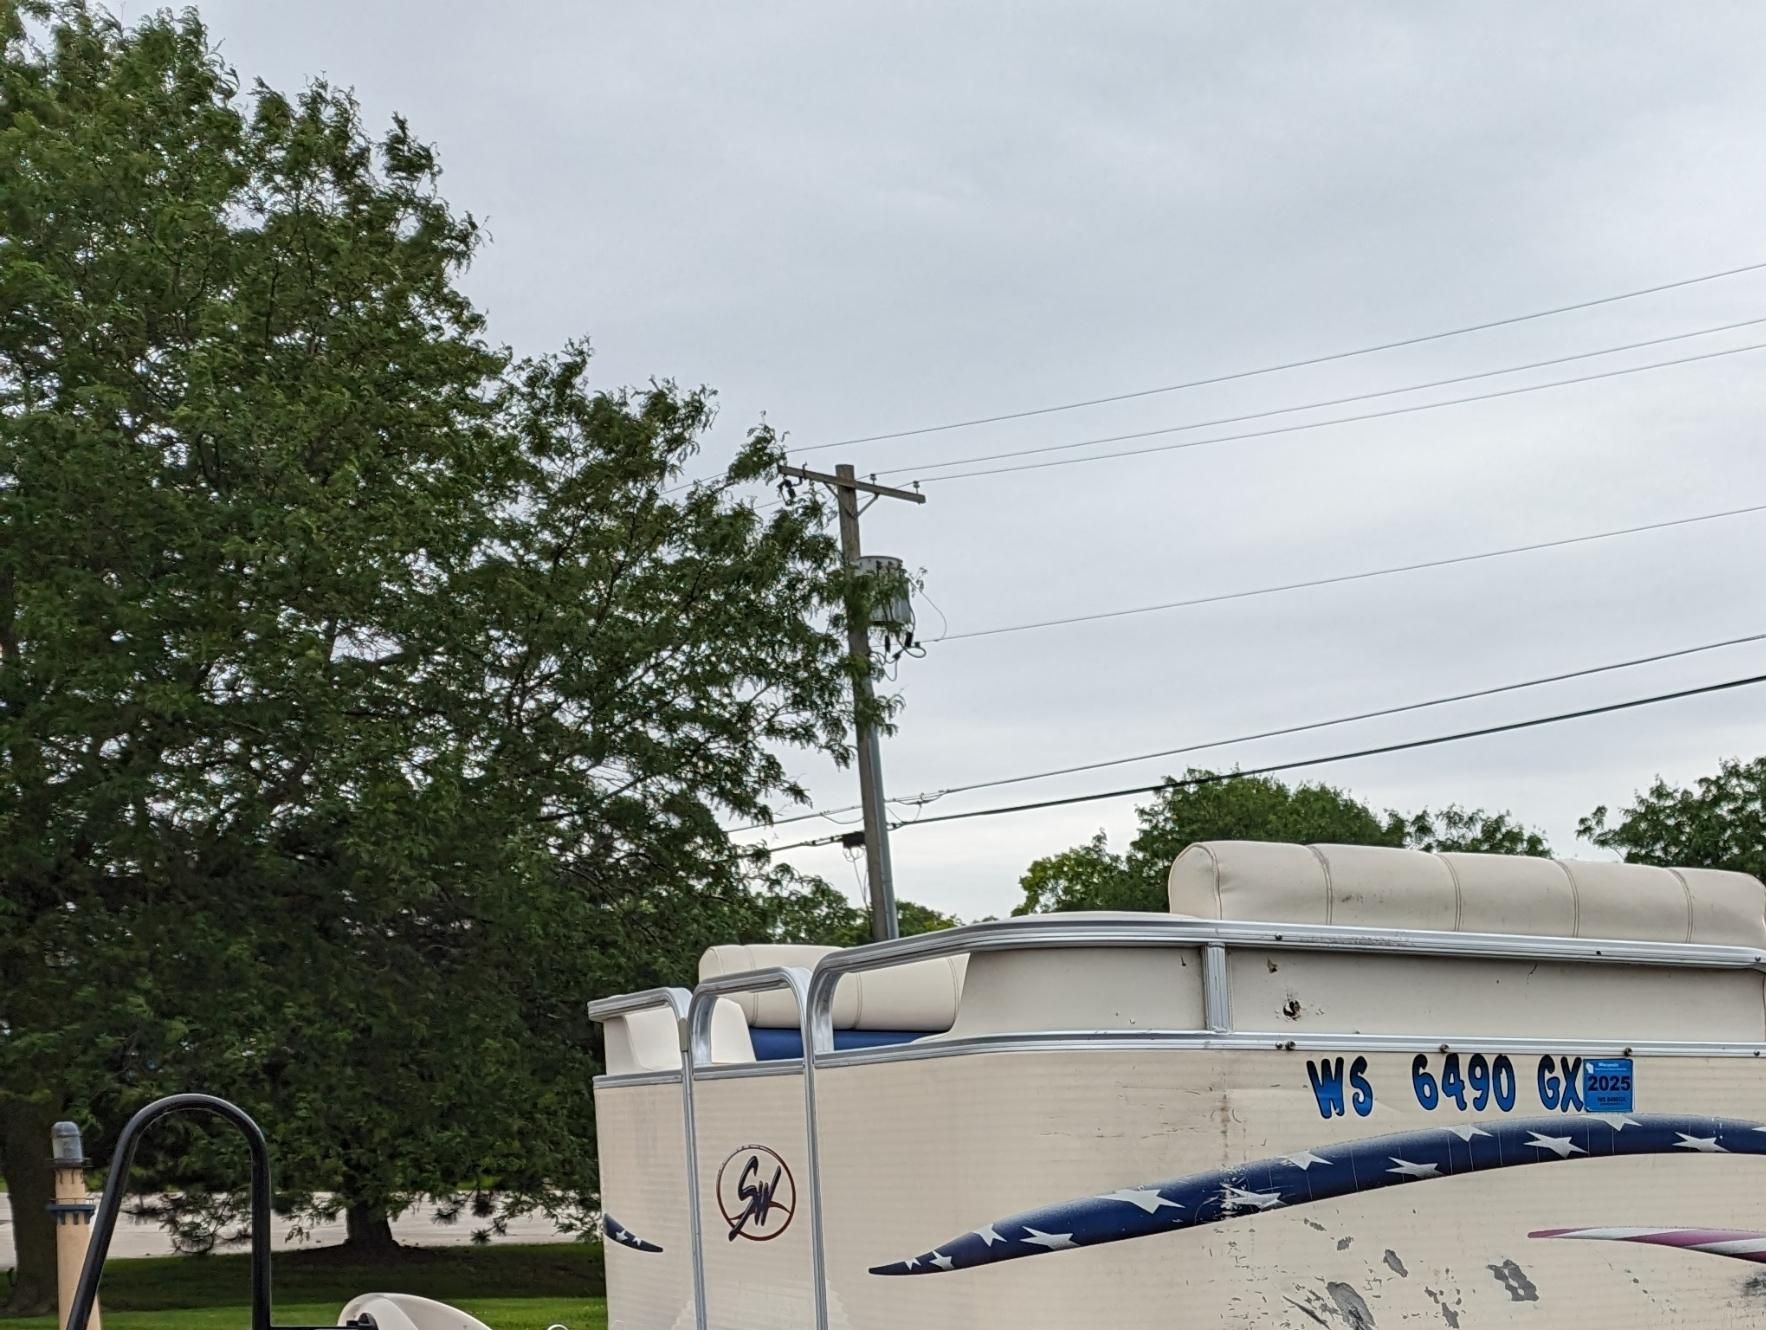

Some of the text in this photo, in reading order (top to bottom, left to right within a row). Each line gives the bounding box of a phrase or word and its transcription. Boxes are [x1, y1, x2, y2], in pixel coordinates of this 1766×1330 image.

[1306, 1053, 1584, 1119] WS 6490 GX
[1588, 1075, 1631, 1091] 2025
